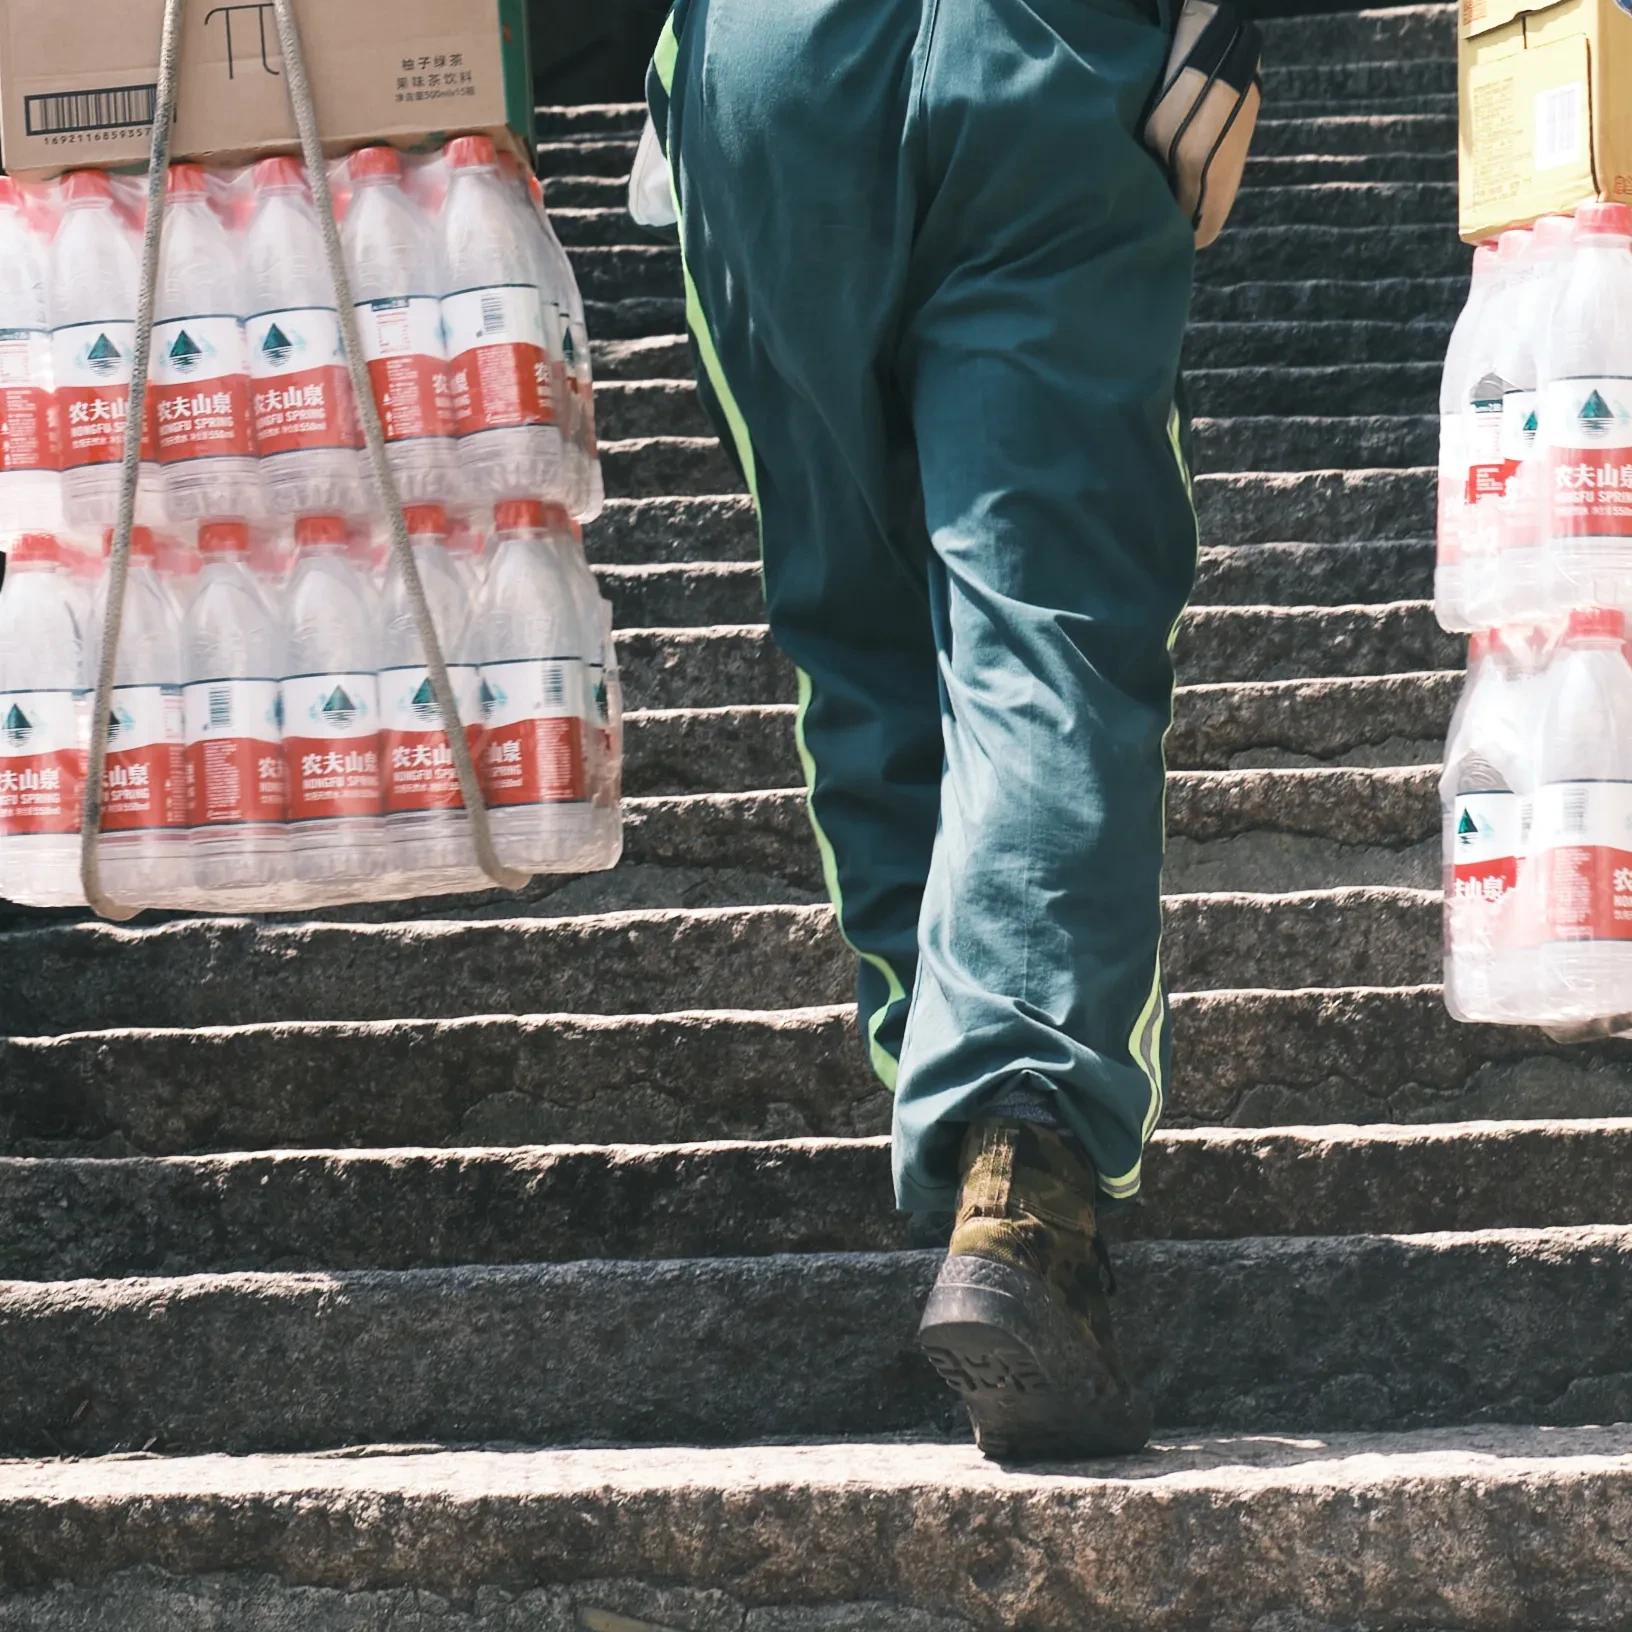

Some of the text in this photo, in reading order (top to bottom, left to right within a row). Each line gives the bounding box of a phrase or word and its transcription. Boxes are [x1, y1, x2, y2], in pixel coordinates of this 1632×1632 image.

[69, 397, 148, 424] 农夫山
[158, 392, 232, 422] 农夫山泉
